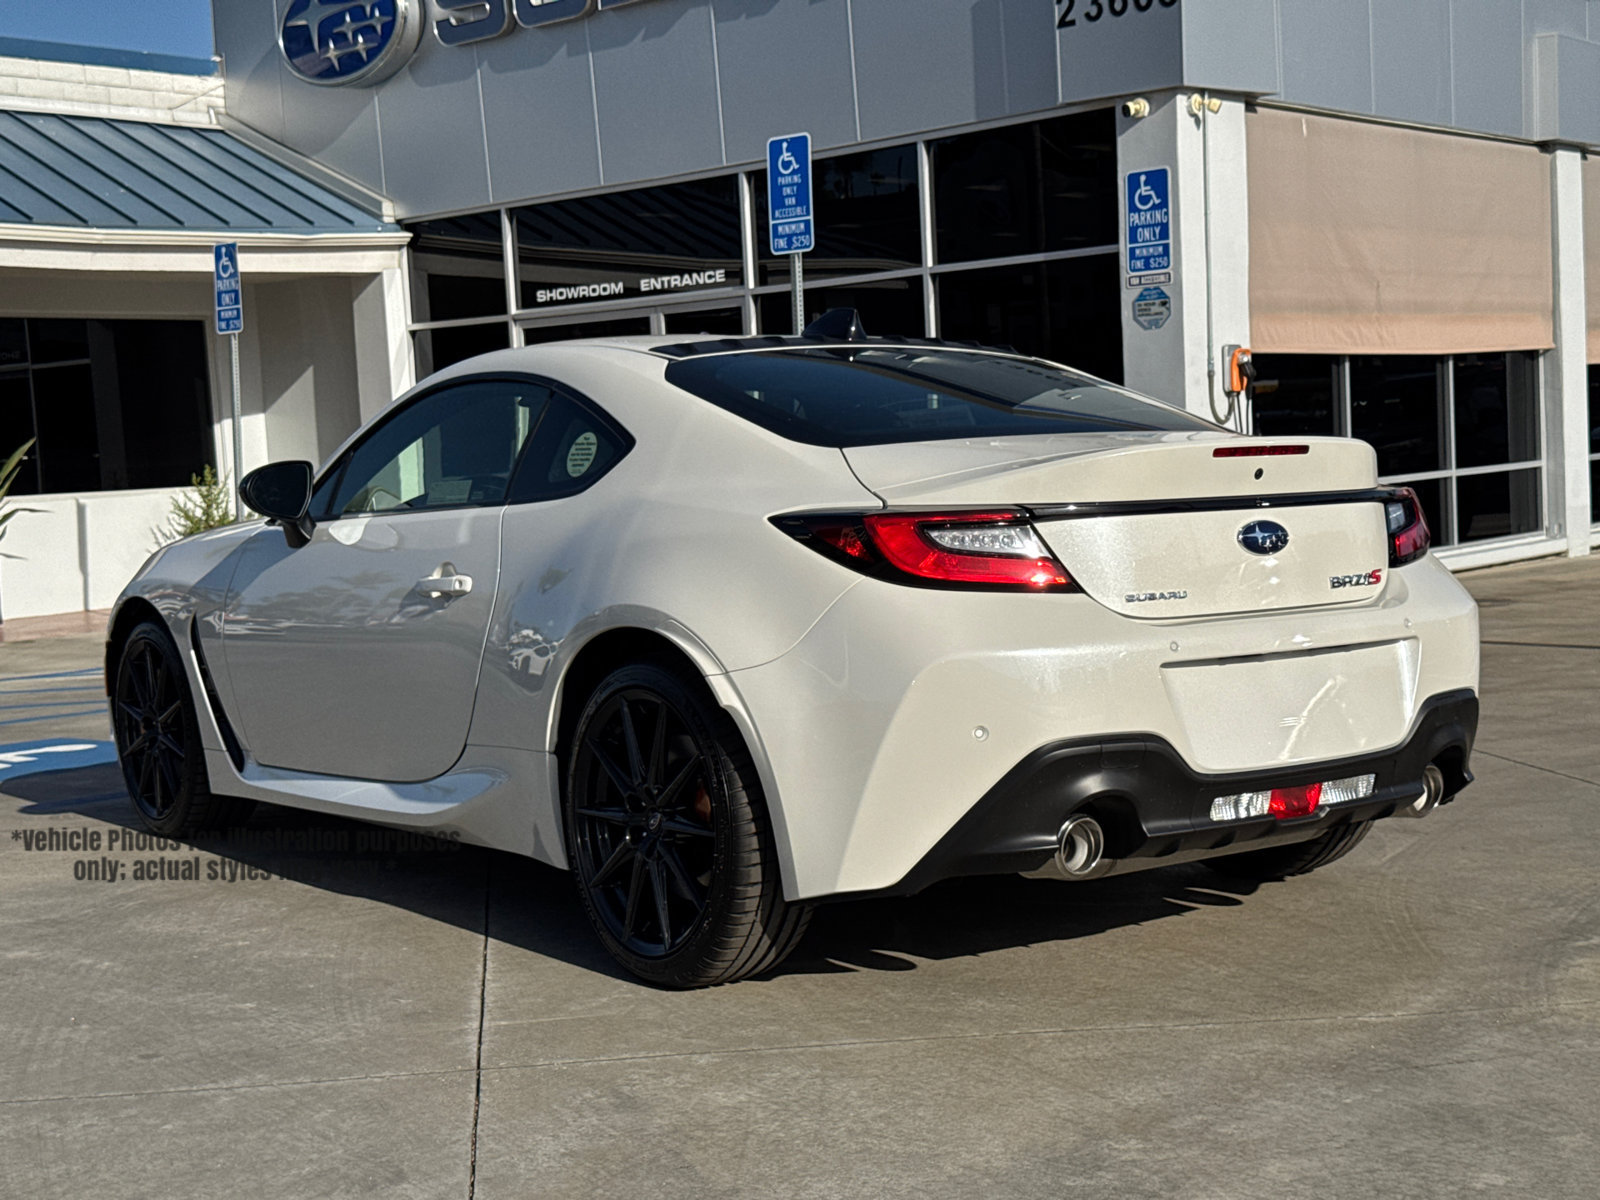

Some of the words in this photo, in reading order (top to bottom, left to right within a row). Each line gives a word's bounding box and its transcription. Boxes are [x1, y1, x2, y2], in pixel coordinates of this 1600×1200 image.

[777, 174, 802, 186] PARKING
[782, 185, 797, 196] ONLY
[774, 205, 807, 218] ACCESSIBLE
[1130, 208, 1168, 227] PARKING
[777, 222, 806, 236] MINIMUM
[1137, 226, 1161, 242] ONLY
[774, 238, 788, 249] FINE
[791, 235, 810, 249] $250
[1135, 246, 1163, 258] MINIMUM
[1131, 258, 1145, 270] FINE
[1150, 256, 1168, 268] $250
[536, 281, 624, 302] SHOWROOM
[640, 269, 726, 292] ENTRANCE
[1124, 590, 1188, 603] SUBARU
